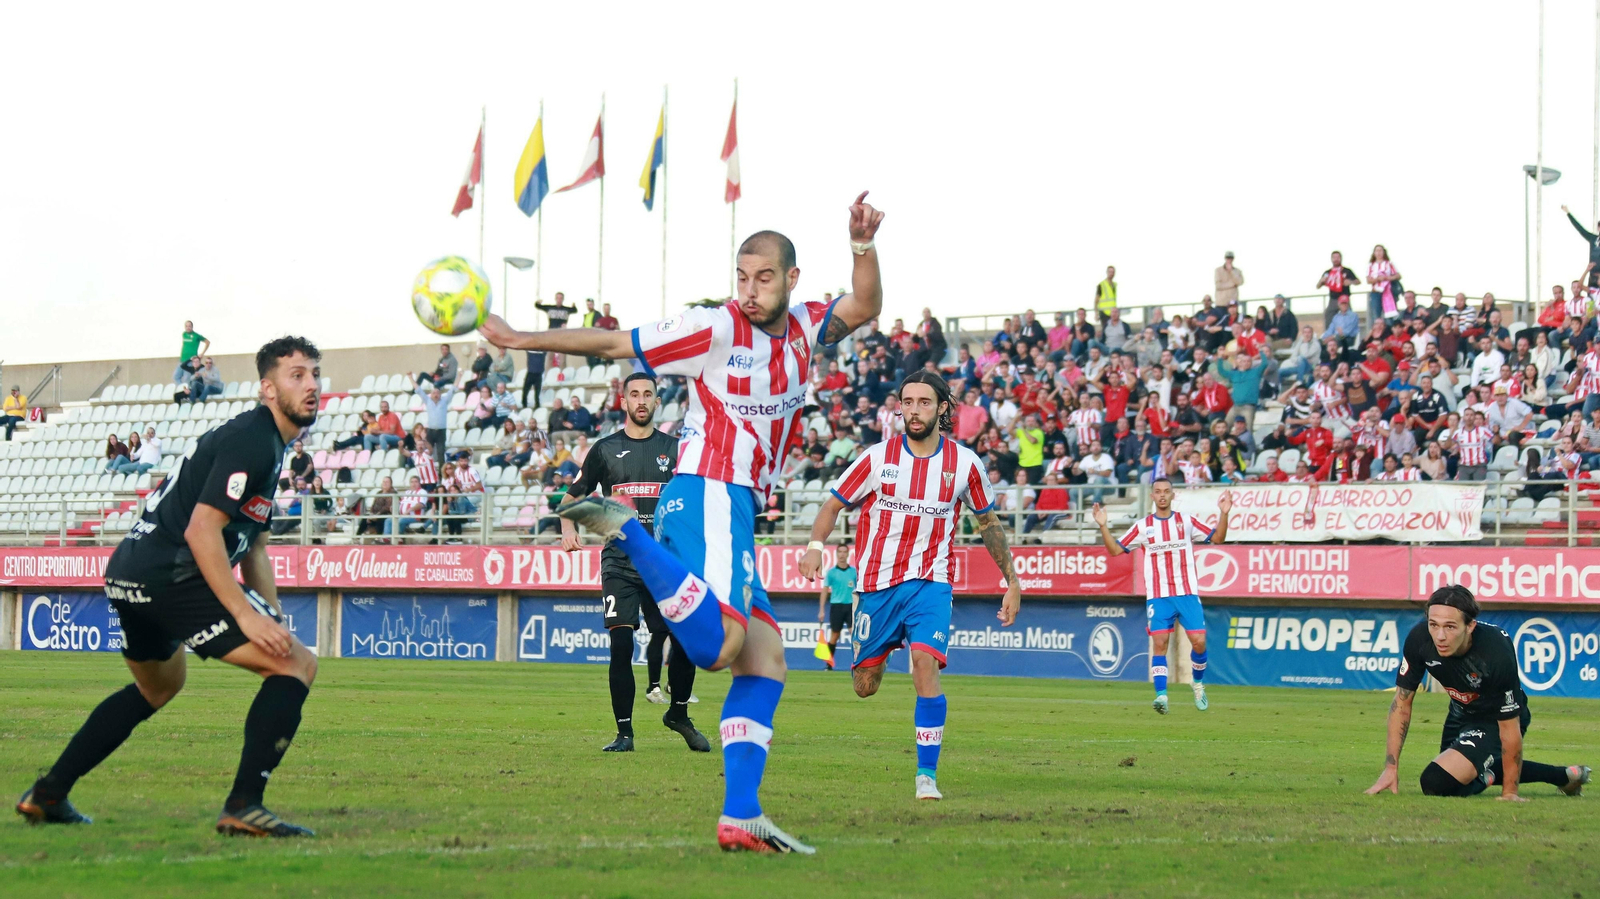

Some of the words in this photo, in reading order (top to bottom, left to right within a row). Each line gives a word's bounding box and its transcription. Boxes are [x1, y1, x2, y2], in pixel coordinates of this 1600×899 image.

[1325, 512, 1347, 531] EL
[1354, 510, 1450, 531] CORAZON
[4, 556, 36, 577] CENTRO
[38, 556, 84, 577] DEPORTIVO
[85, 556, 97, 577] LA
[306, 548, 342, 585] Pepe
[345, 549, 408, 581] Valencia
[423, 552, 461, 566] BOUTIQUE
[511, 549, 603, 585] PADIL
[1011, 550, 1107, 575] ocialistas
[1248, 548, 1350, 571] HYUNDAI
[415, 568, 425, 581] DE
[426, 568, 474, 582] CABALLEROS
[1248, 573, 1350, 595] PERMOTOR
[468, 599, 487, 607] BAR
[553, 604, 586, 613] MOBILIARIO
[586, 605, 594, 613] DE
[1086, 605, 1126, 618] ŠKODA
[28, 596, 101, 651] Castro
[1227, 616, 1400, 653] EUROPEA
[352, 633, 487, 659] Manhattan
[550, 627, 611, 654] AlgeTon
[1026, 626, 1075, 650] Motor
[1570, 632, 1600, 661] po
[1344, 656, 1399, 671] GROUP
[1523, 640, 1556, 673] PP
[1580, 663, 1598, 681] de
